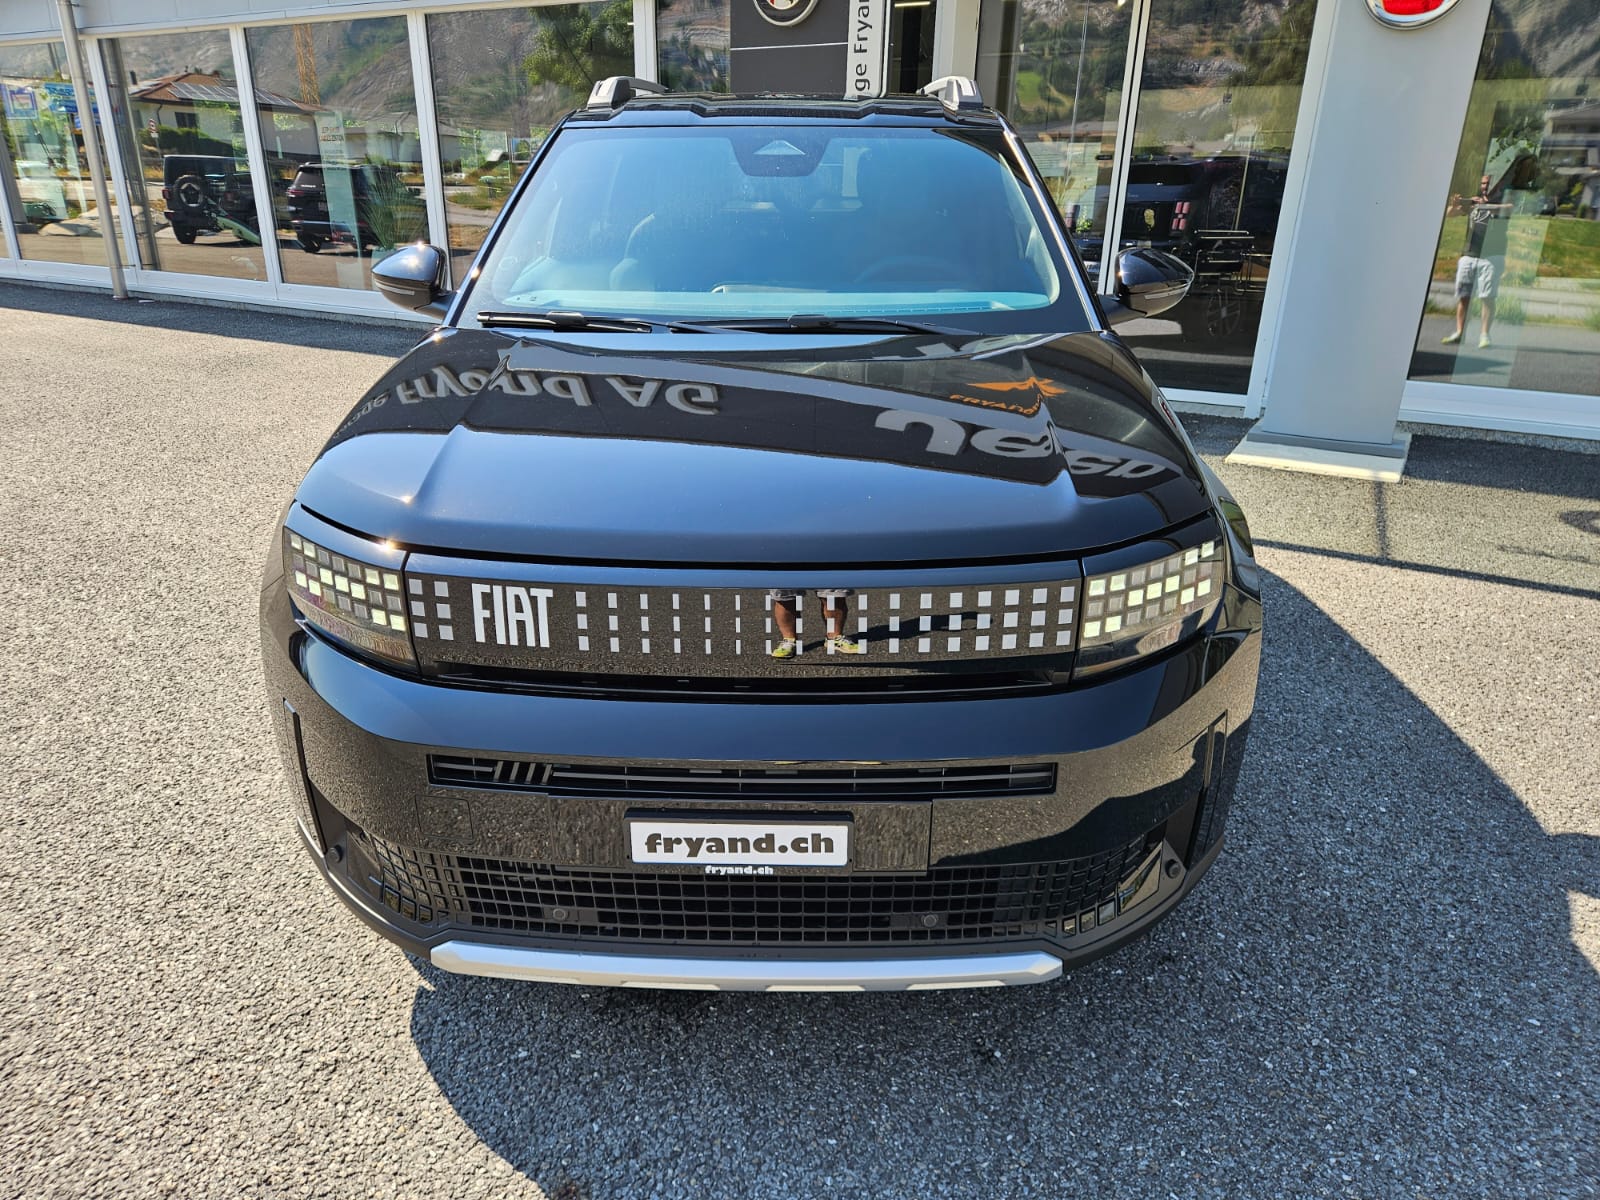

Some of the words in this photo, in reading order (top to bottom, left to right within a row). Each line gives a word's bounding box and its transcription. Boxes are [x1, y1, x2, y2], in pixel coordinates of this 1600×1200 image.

[854, 0, 872, 53] Frya
[472, 583, 553, 648] FIAT
[645, 833, 834, 857] fryand.ch
[705, 865, 774, 876] fryand.ch
